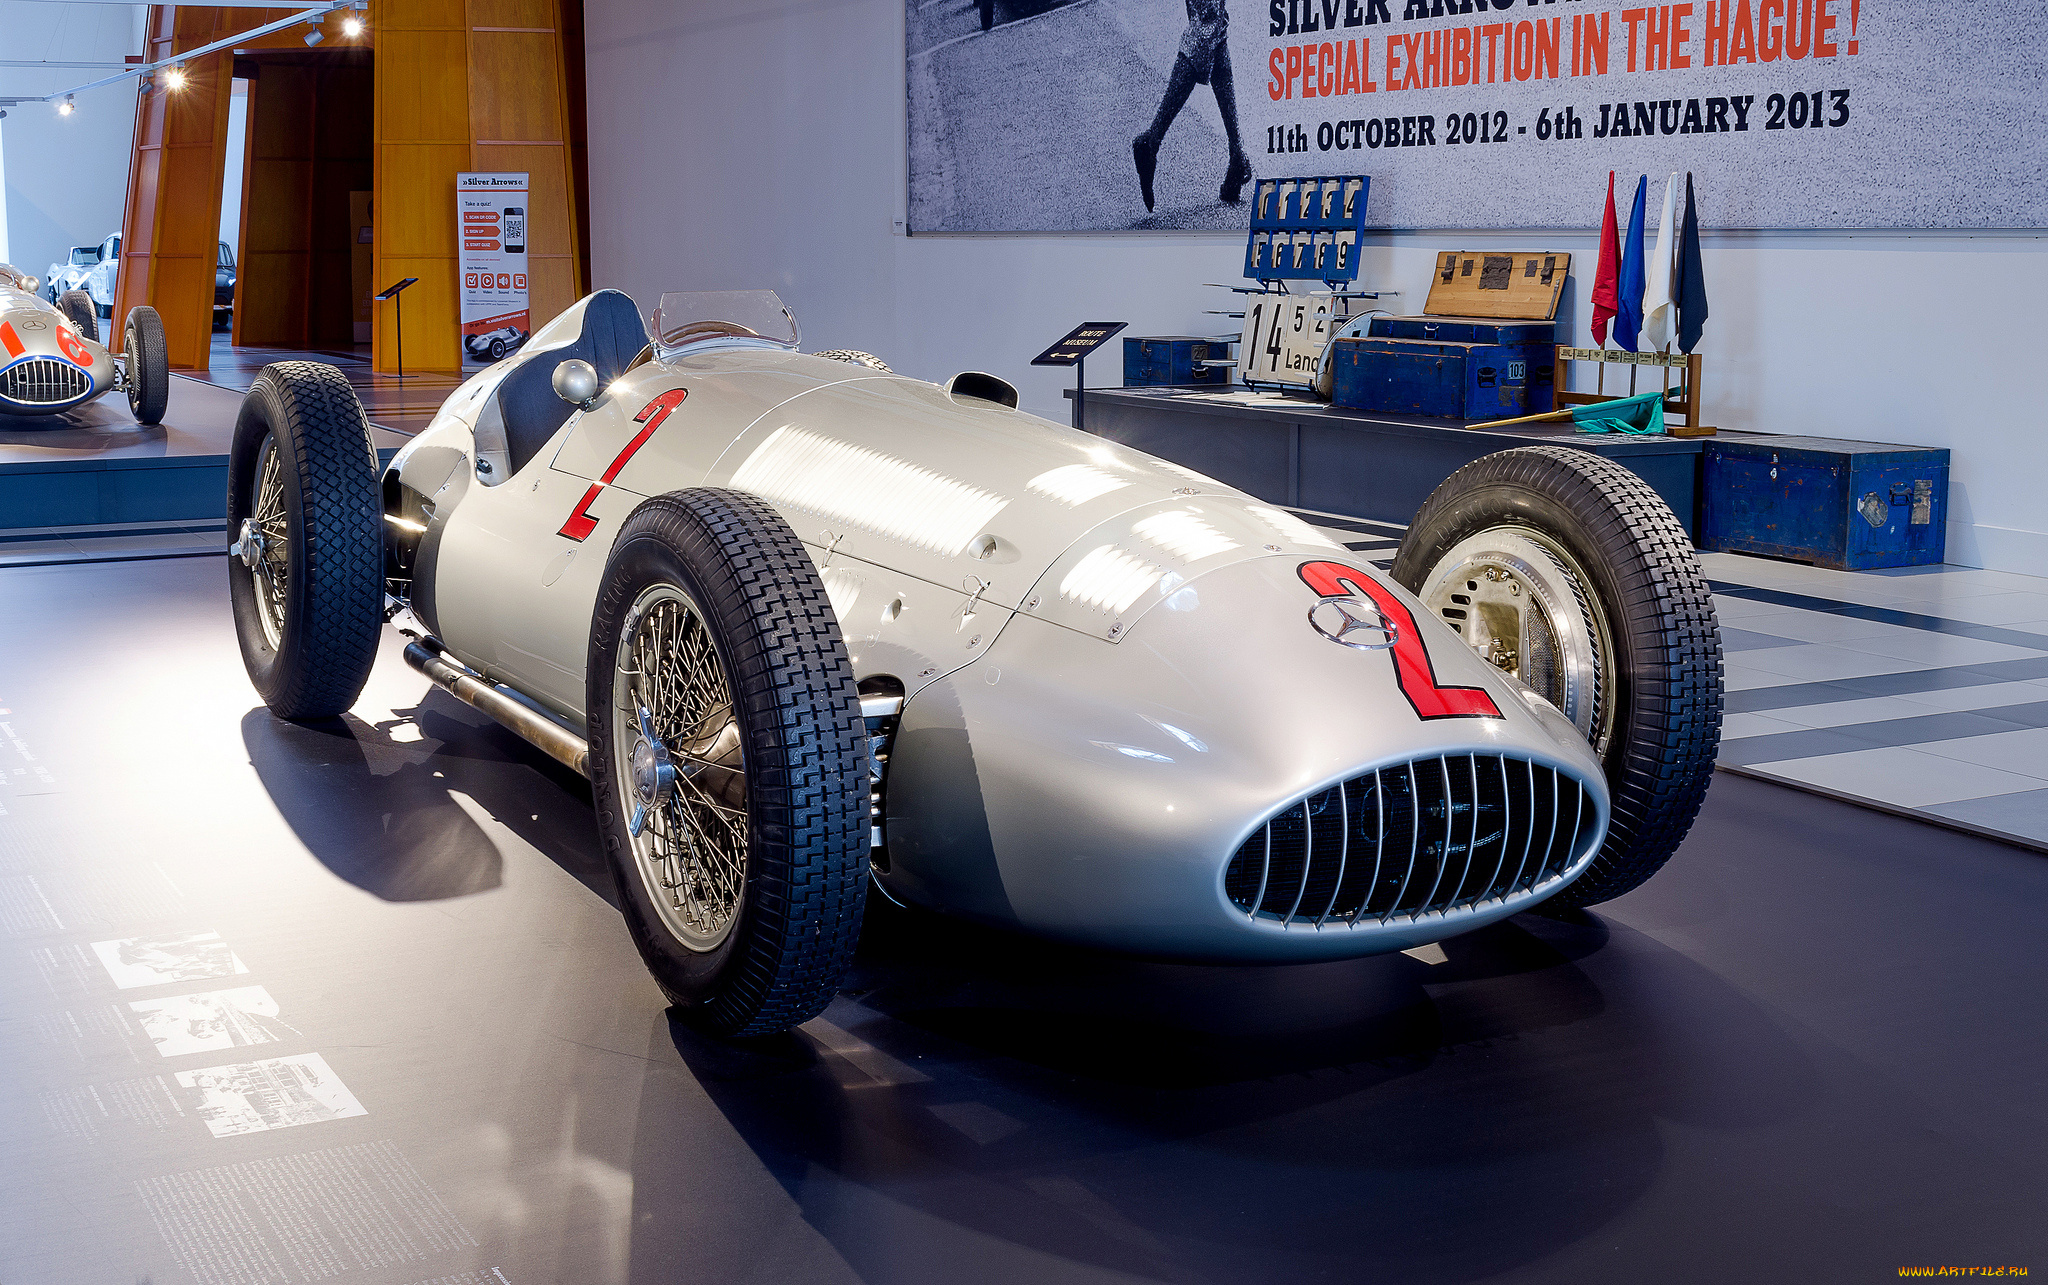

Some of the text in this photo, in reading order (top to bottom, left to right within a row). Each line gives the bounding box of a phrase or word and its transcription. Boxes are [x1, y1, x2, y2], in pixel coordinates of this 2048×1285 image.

[1268, 38, 1377, 101] SPECIAL
[1386, 17, 1561, 92] EXHIBITION
[1571, 11, 1610, 77] IN
[1622, 3, 1693, 73] THE
[1270, 0, 1391, 37] SILVER
[1268, 89, 1850, 153] 11th OCTOBER 2012 - 6th JANUARY 2013
[1338, 241, 1347, 268] 9
[1509, 363, 1525, 378] 103
[556, 387, 689, 543] 2
[1296, 560, 1506, 721] 2
[590, 712, 621, 855] DUNLOP
